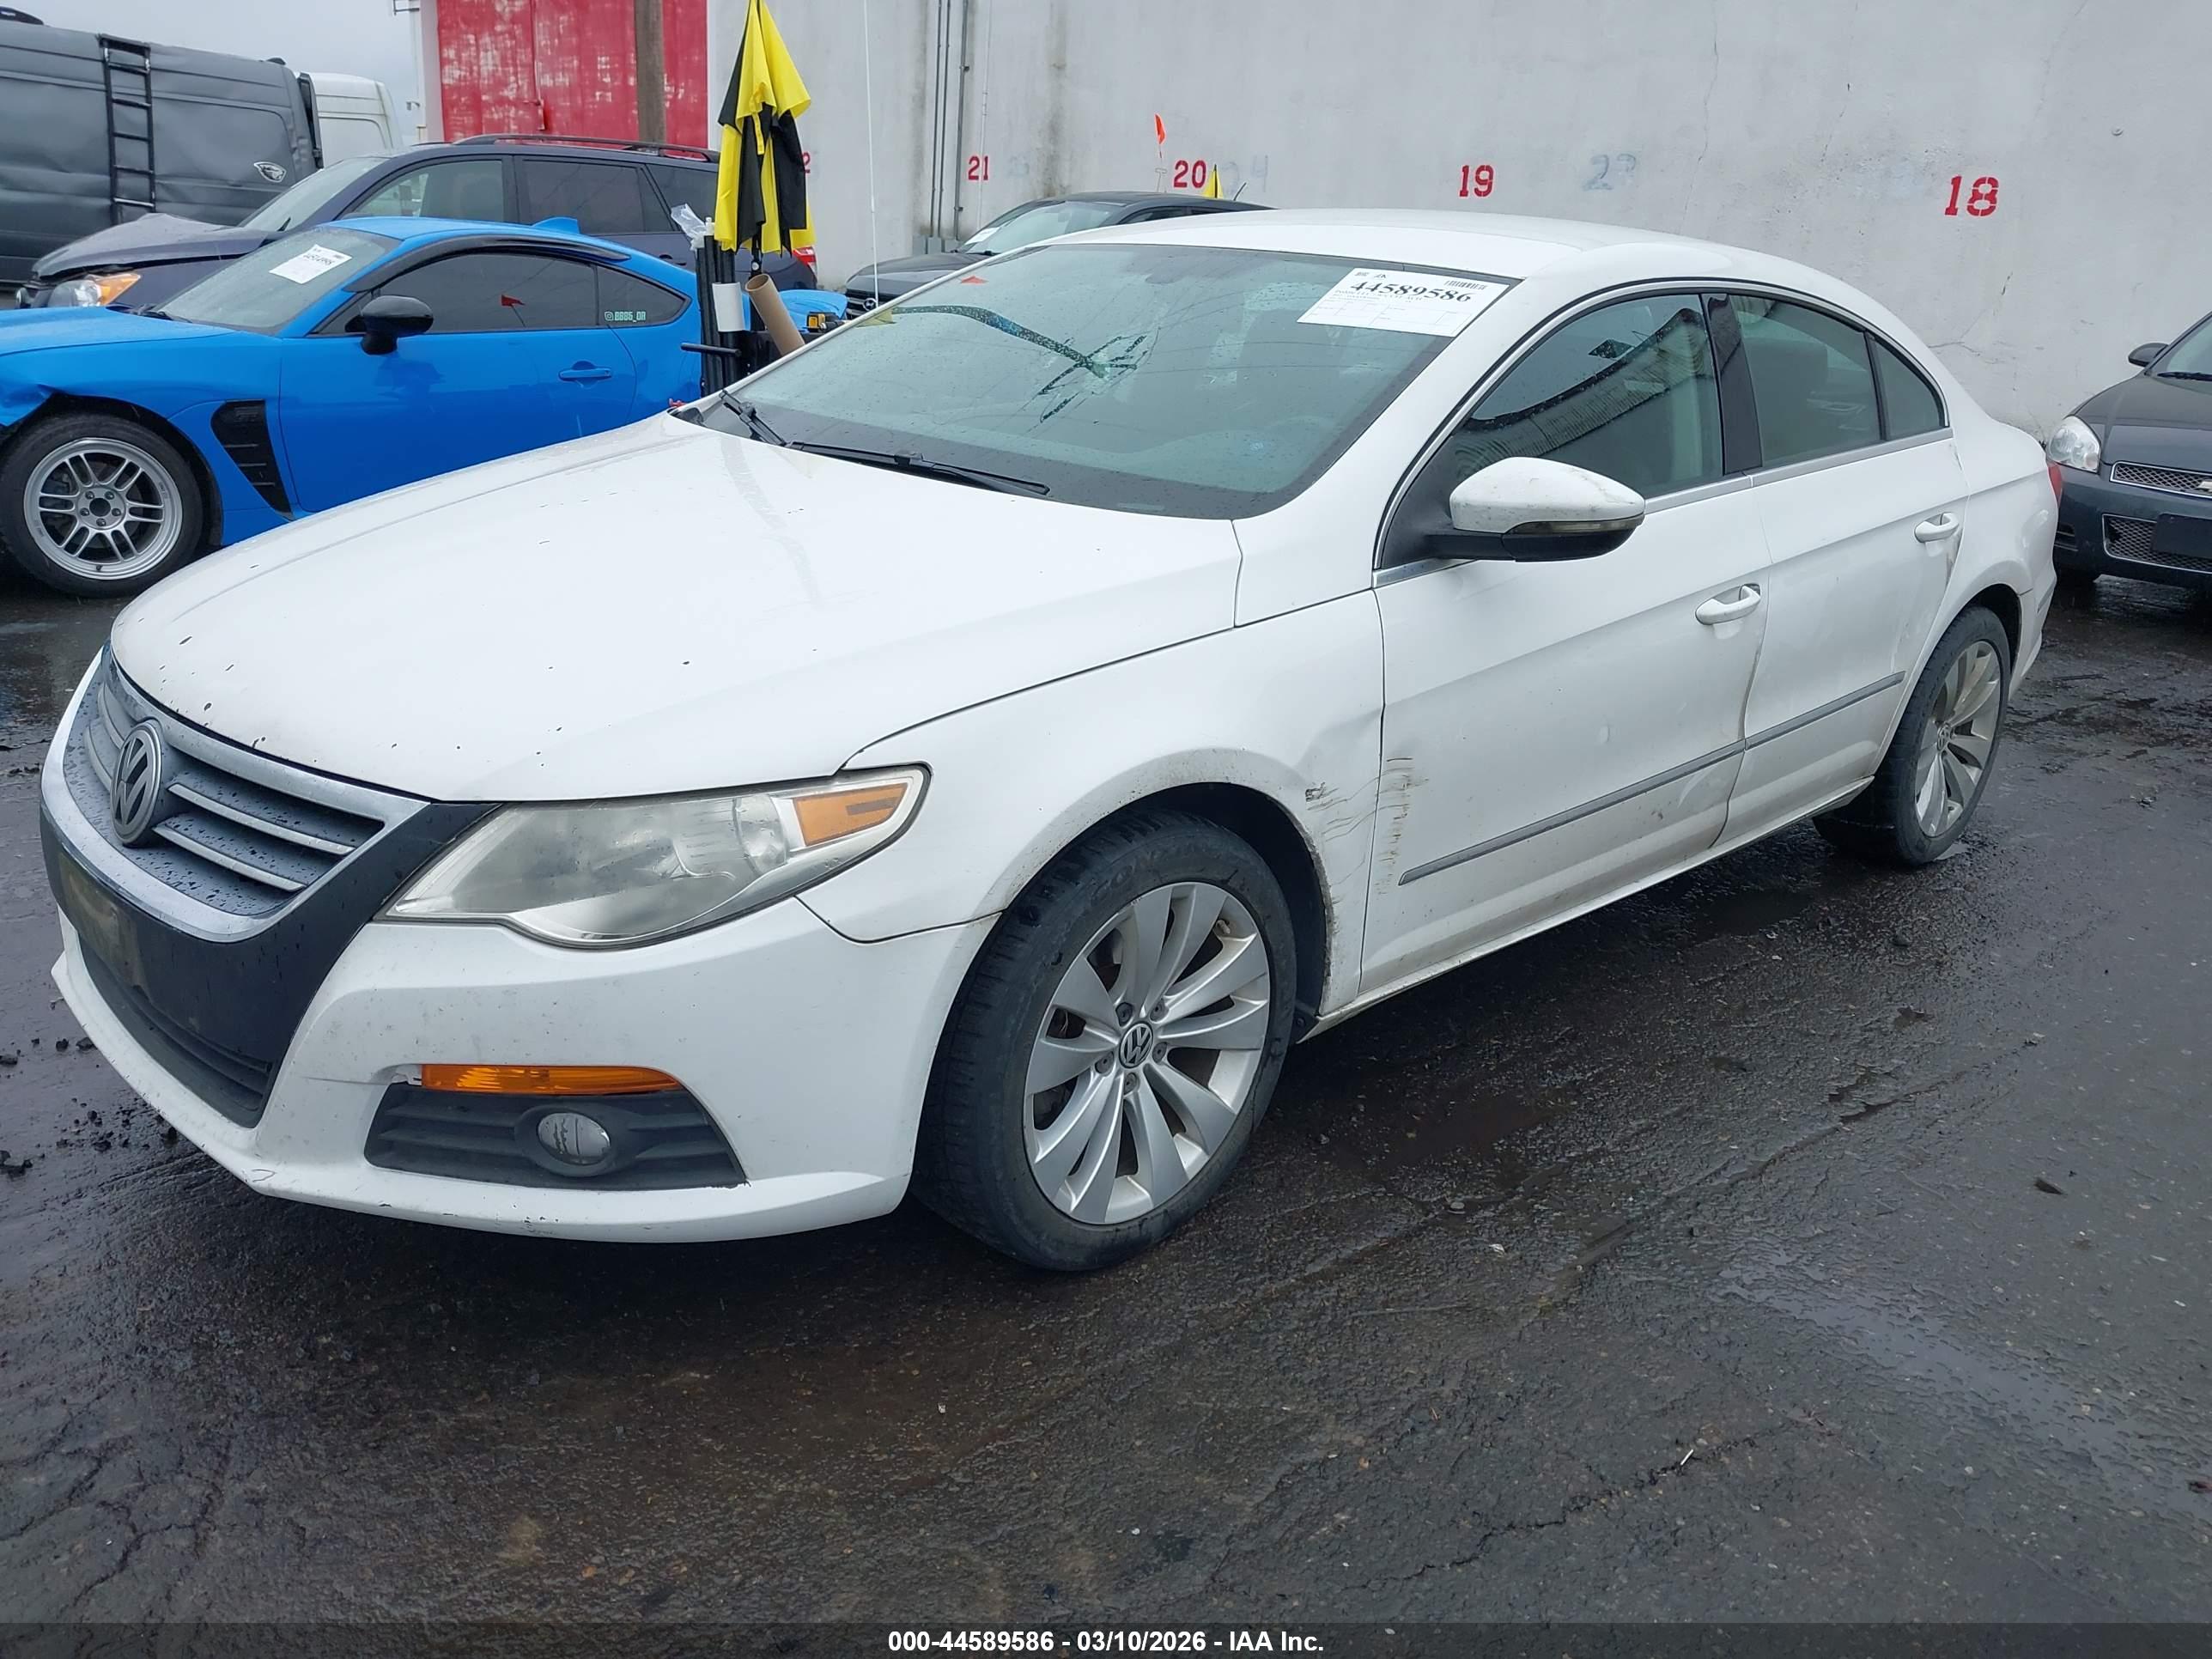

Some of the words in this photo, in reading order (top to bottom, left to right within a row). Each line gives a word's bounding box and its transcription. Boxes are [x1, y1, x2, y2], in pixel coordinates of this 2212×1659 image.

[968, 155, 988, 180] 21
[1173, 160, 1206, 188] 20
[1459, 165, 1494, 198] 19
[1945, 175, 1999, 216] 18
[1351, 281, 1472, 302] 44589586
